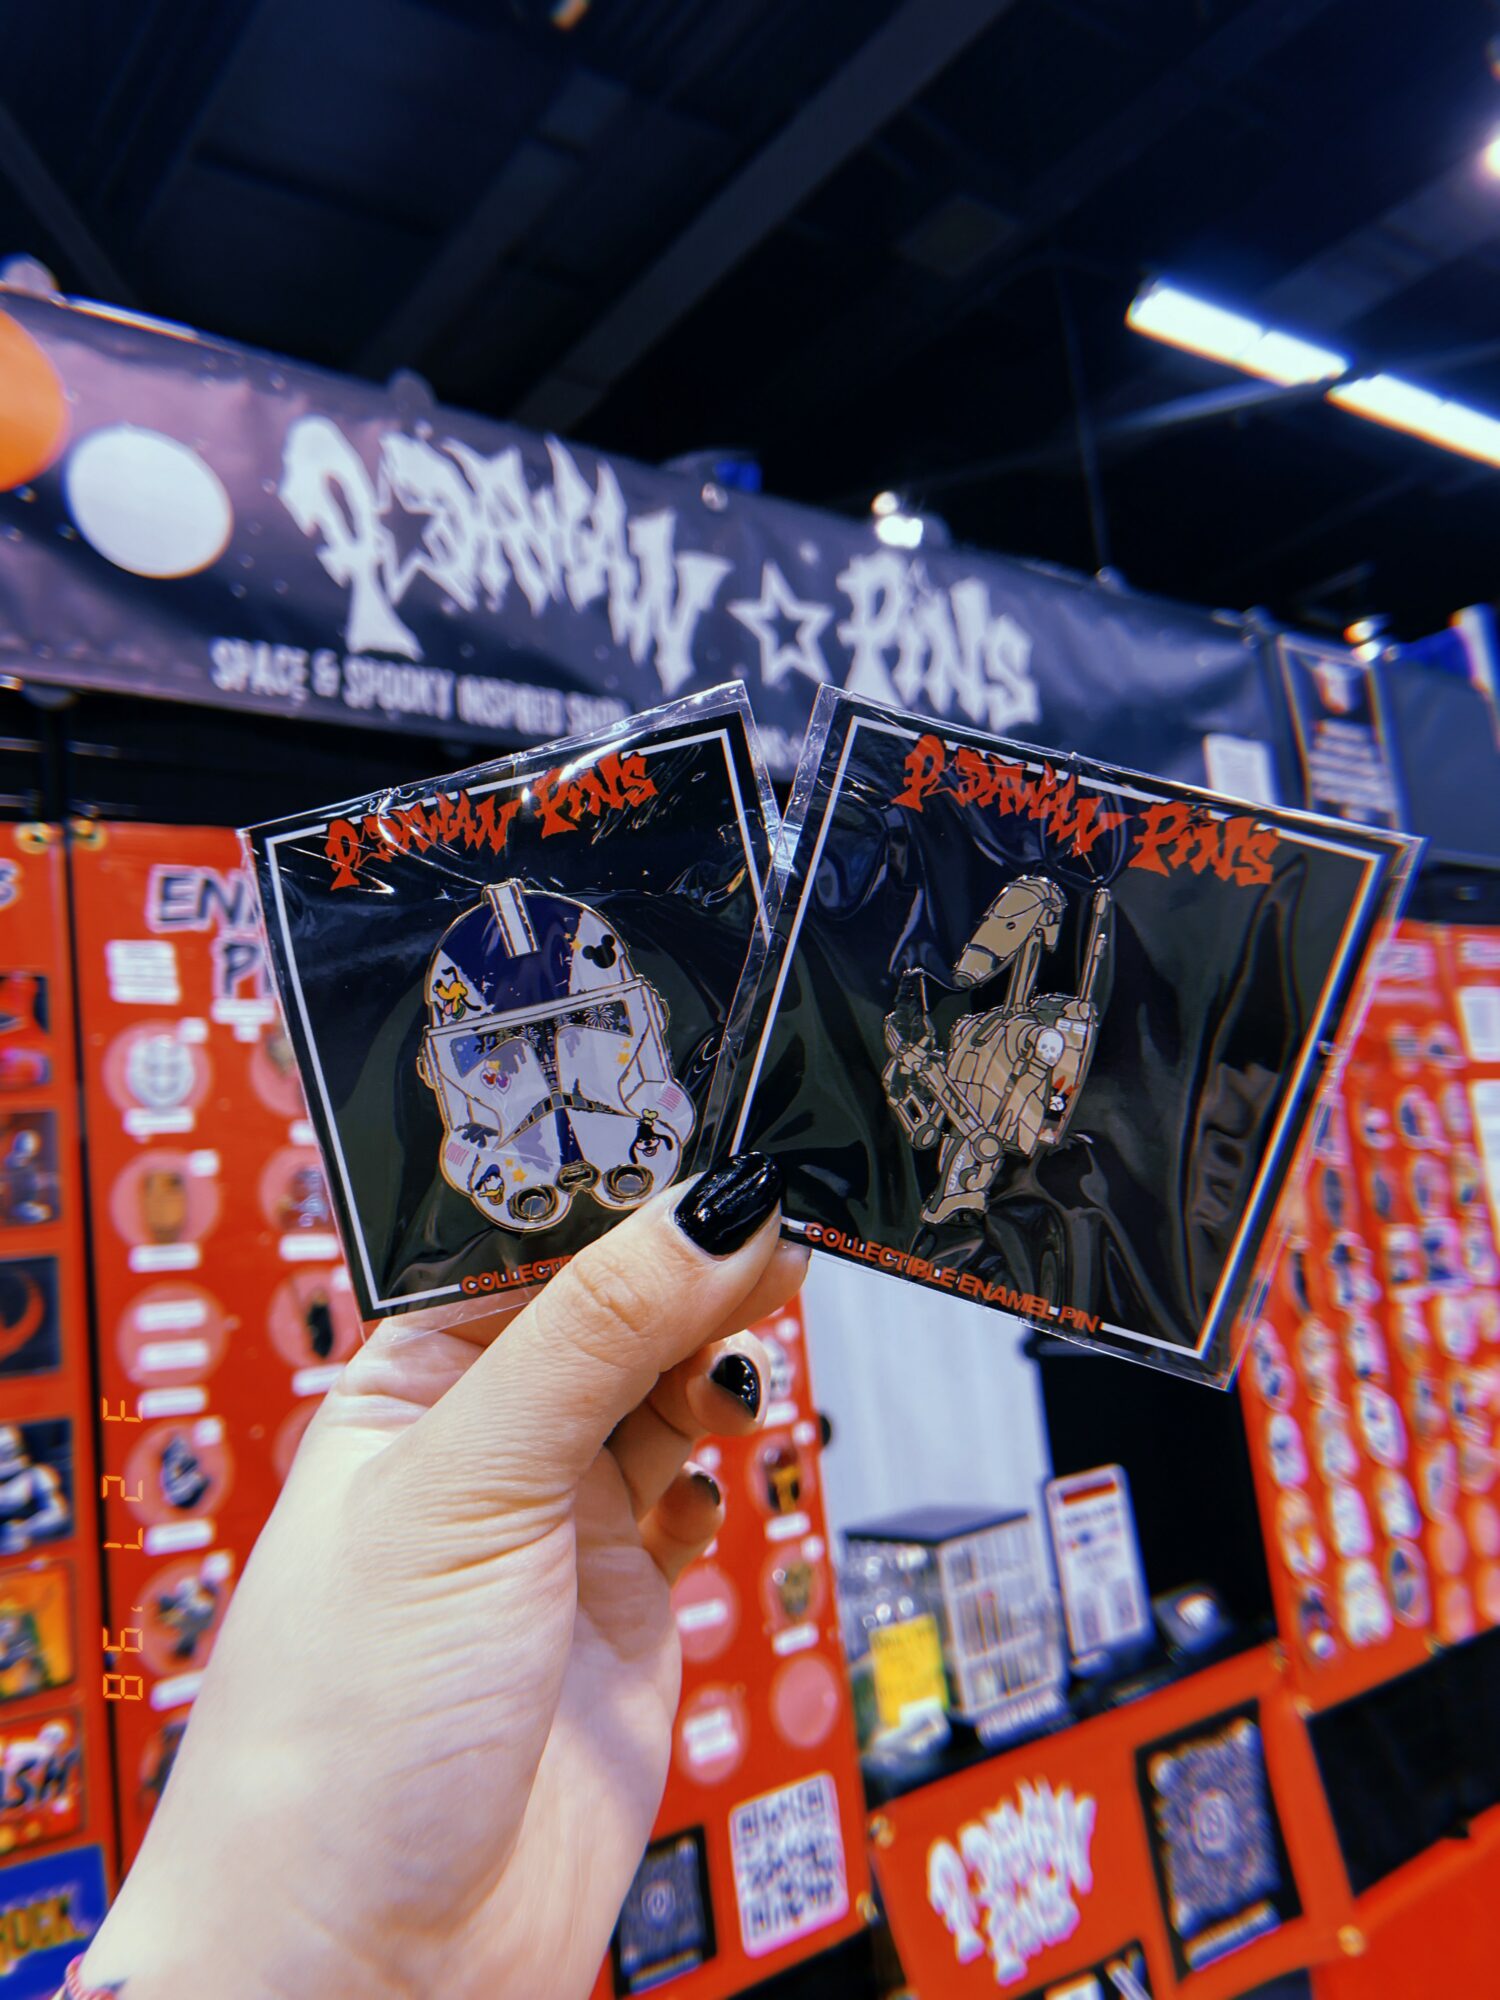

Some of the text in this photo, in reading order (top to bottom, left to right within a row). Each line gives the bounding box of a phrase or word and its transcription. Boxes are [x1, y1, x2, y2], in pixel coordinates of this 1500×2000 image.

[209, 636, 309, 700] SPACE
[311, 648, 341, 698] &
[343, 655, 457, 721] SPOOKY
[804, 1222, 1101, 1334] COLLECTIBLE ENAMEL PIN
